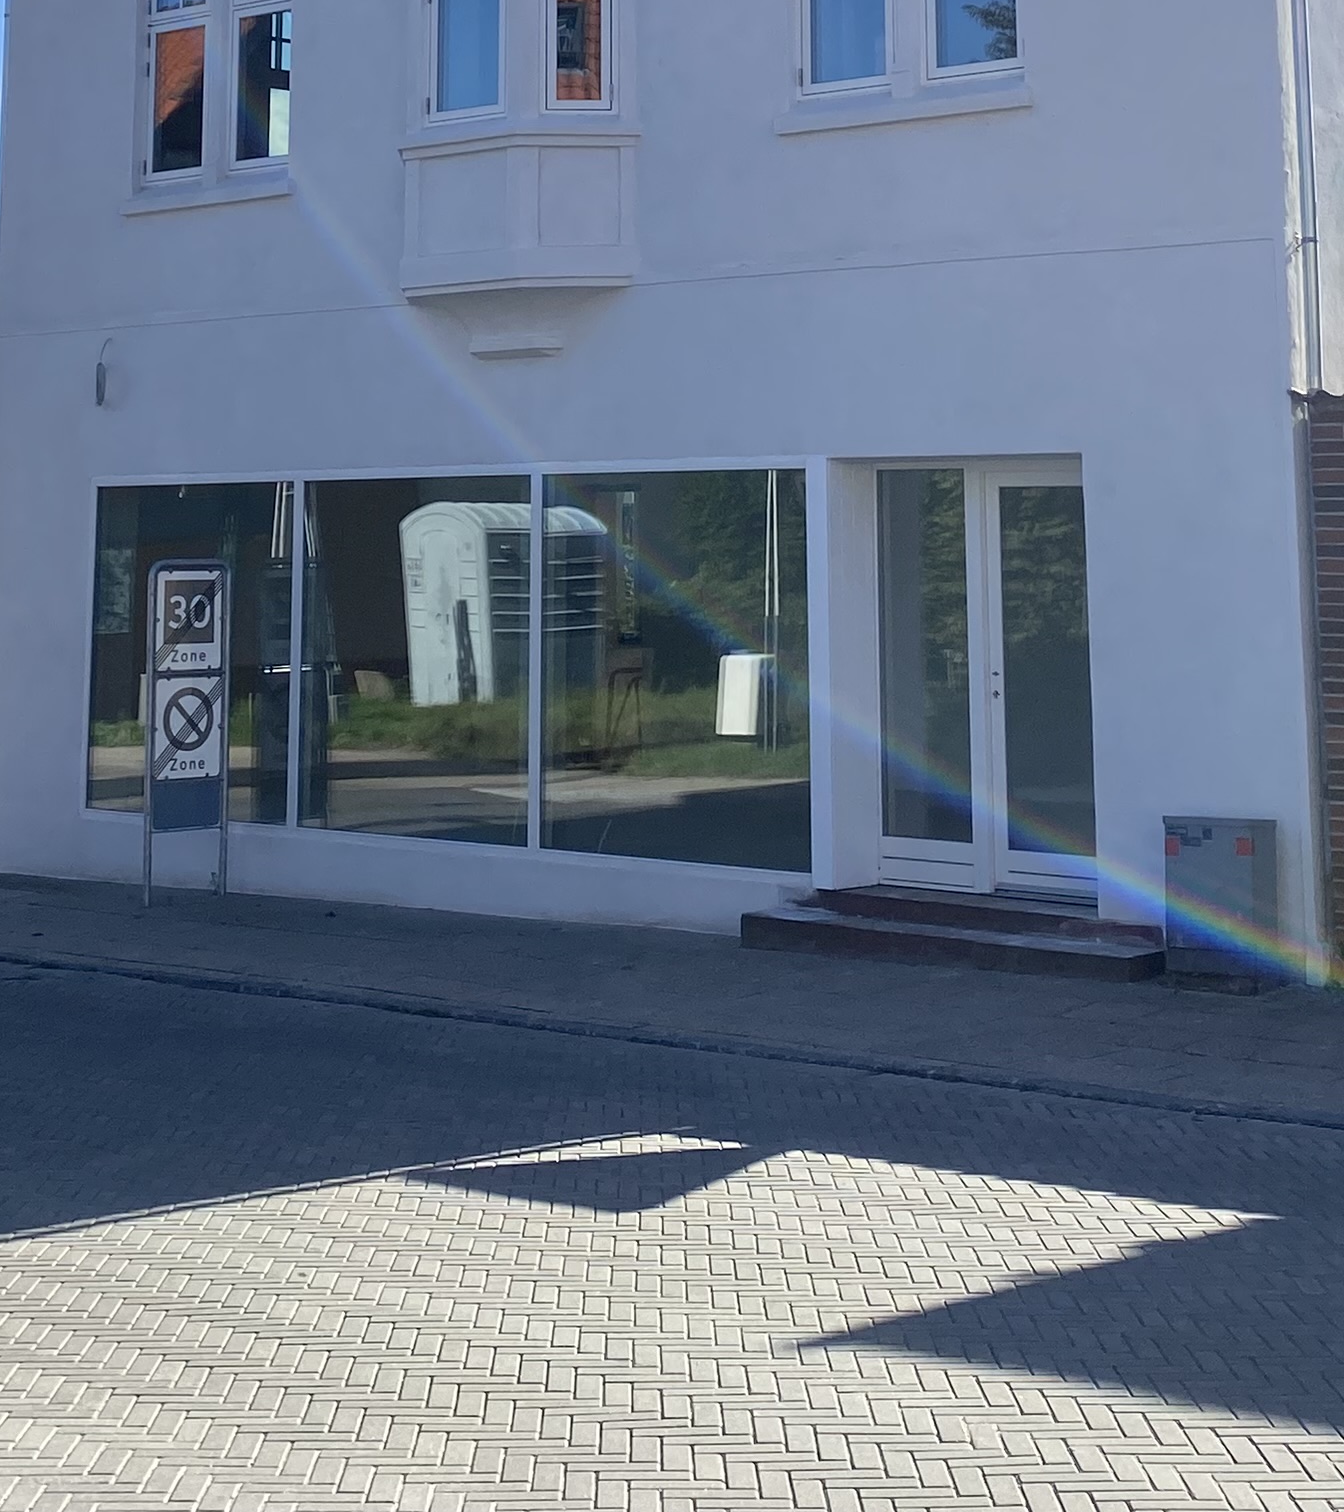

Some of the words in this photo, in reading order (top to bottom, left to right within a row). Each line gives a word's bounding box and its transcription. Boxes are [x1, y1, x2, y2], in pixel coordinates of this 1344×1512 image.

[168, 594, 211, 629] 30
[170, 649, 207, 663] Zone
[169, 757, 206, 772] Zone
